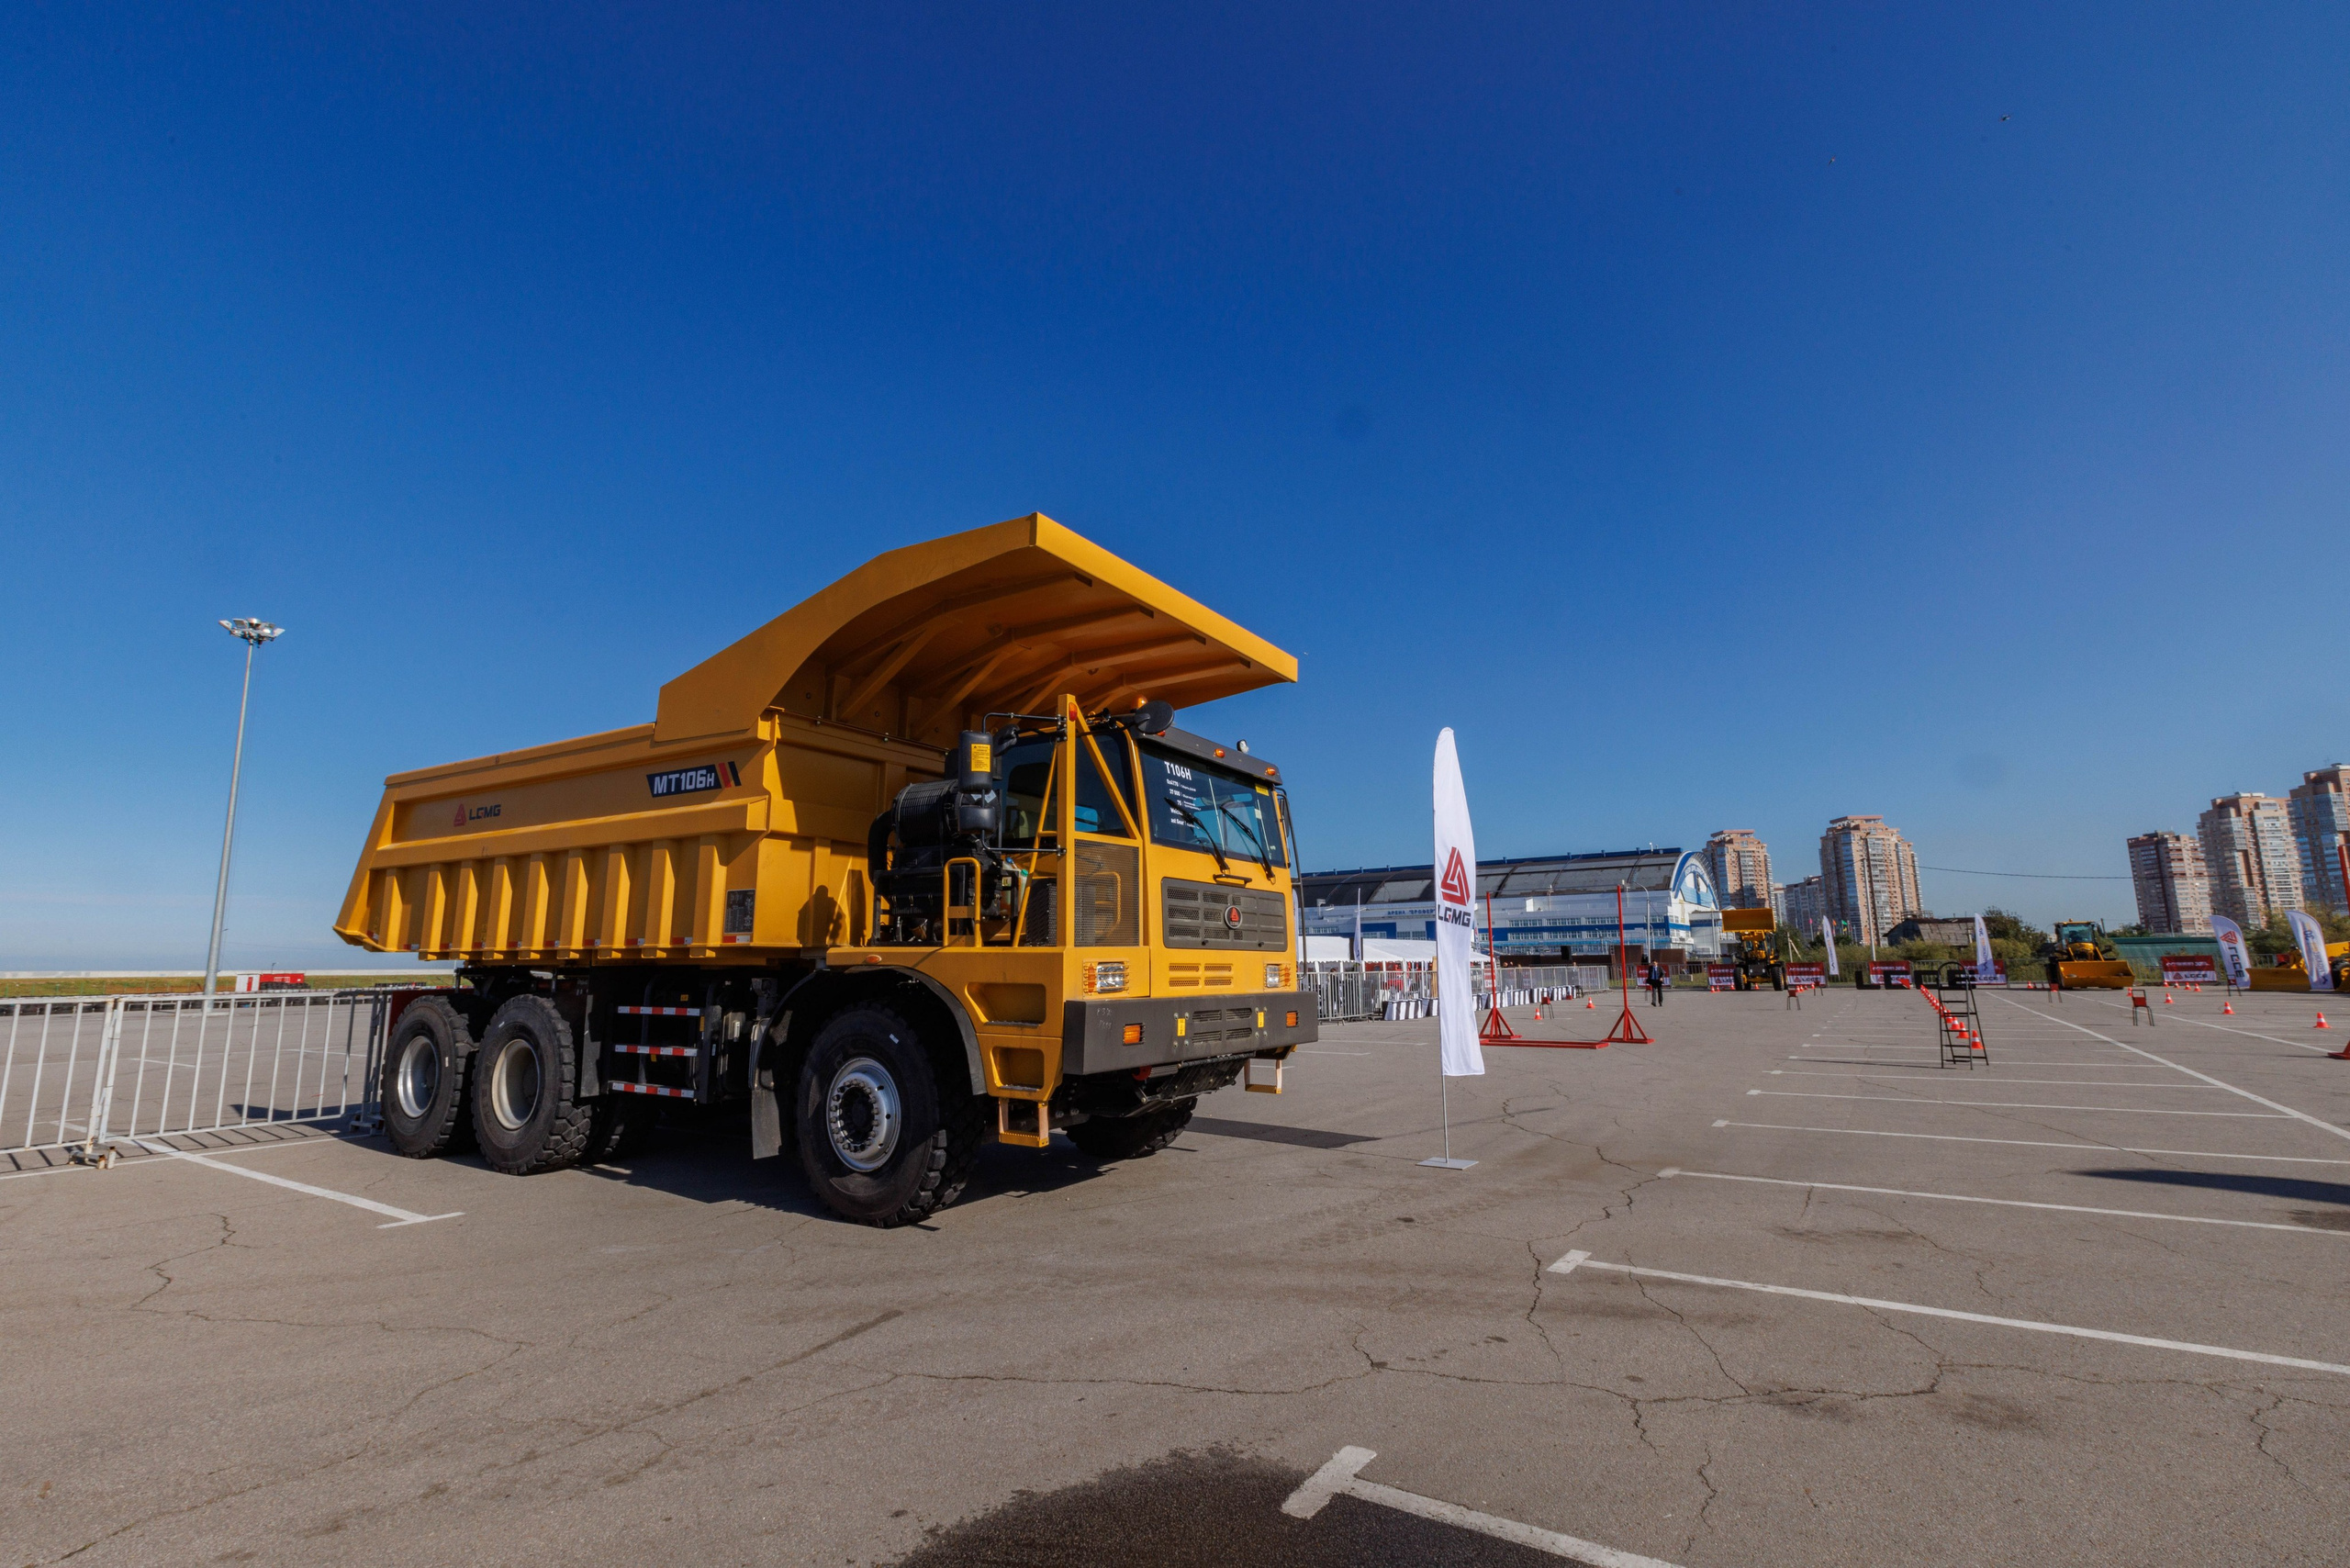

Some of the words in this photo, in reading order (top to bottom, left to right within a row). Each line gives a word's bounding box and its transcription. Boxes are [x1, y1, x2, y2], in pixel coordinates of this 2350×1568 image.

[654, 769, 715, 795] MT106H
[1164, 761, 1192, 780] T106H
[469, 804, 502, 821] LGMG
[1438, 904, 1472, 928] LGMG
[2228, 946, 2245, 978] LGCE
